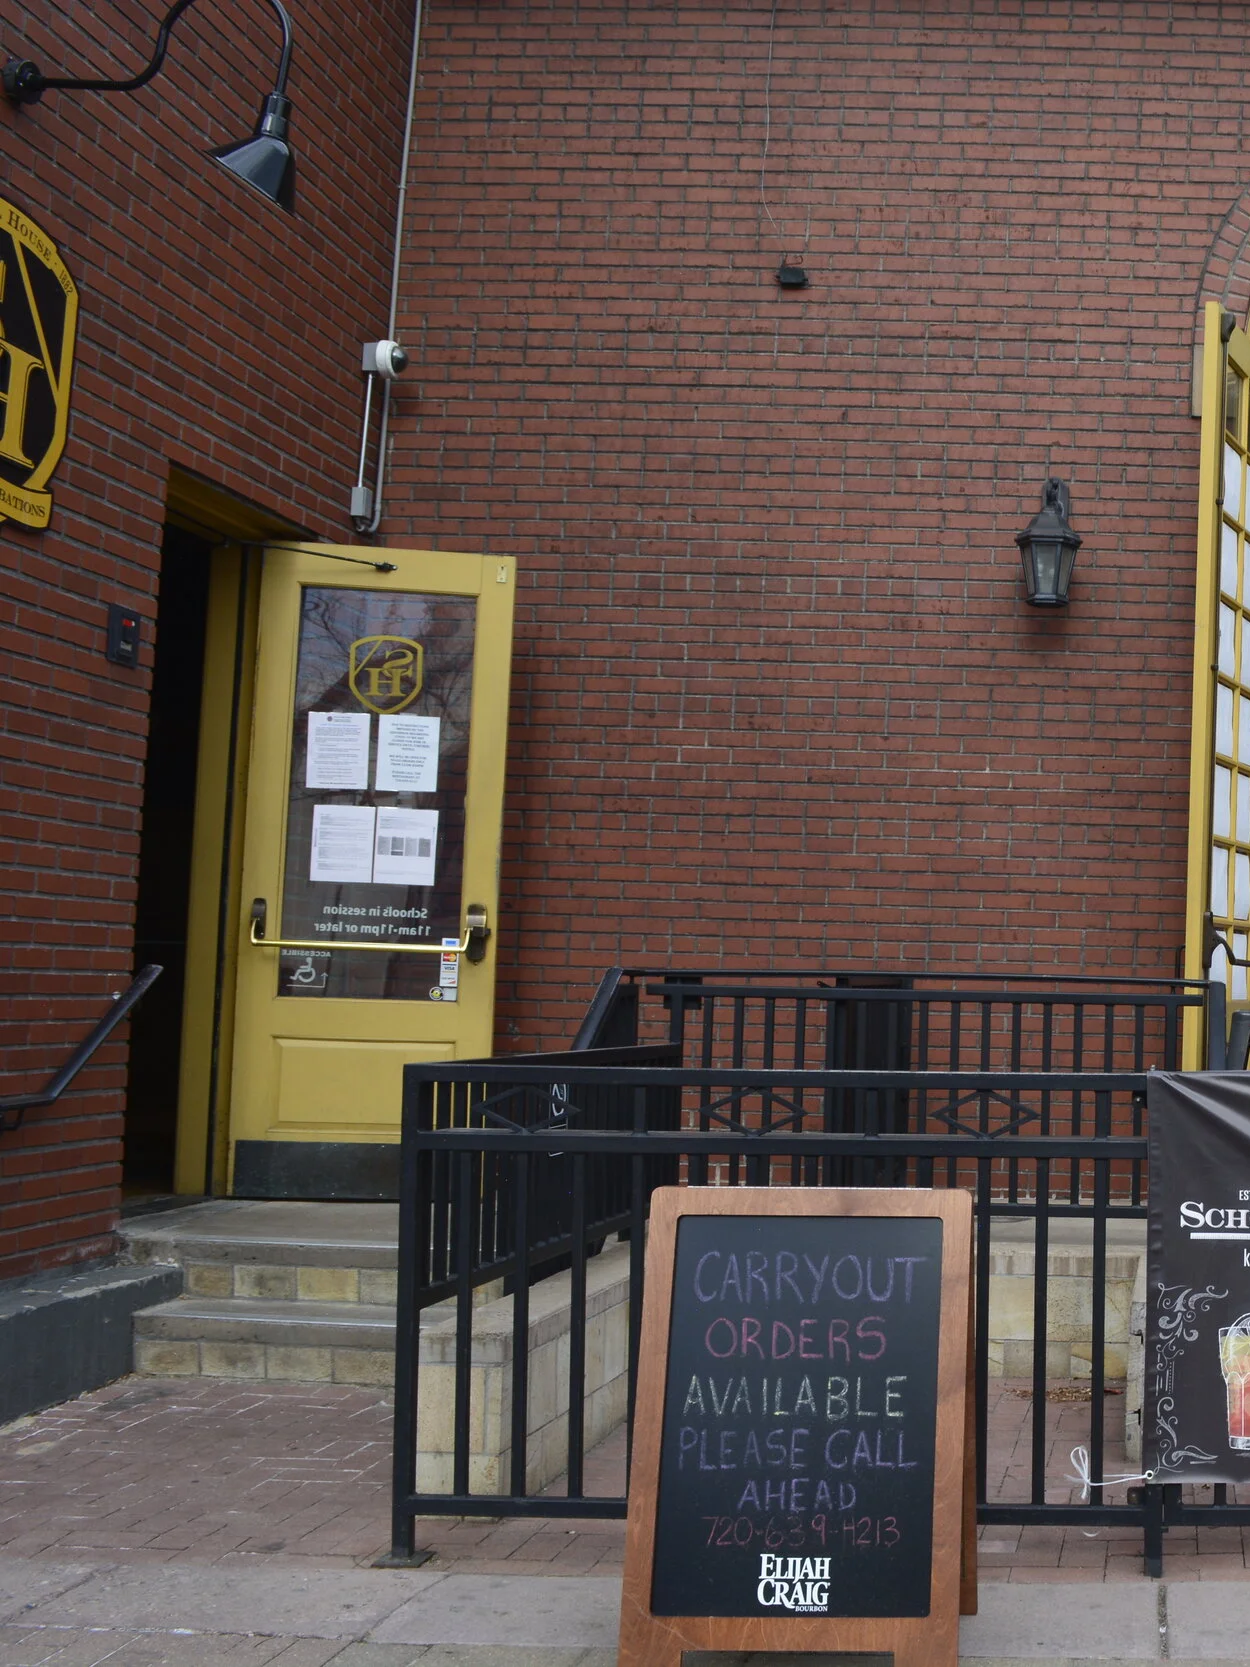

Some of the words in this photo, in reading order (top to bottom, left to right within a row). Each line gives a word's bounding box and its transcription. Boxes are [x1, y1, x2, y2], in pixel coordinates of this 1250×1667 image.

[7, 208, 52, 261] HOUSE
[58, 269, 74, 297] 1882
[0, 488, 46, 518] BATIONS
[693, 1250, 928, 1304] CARRYOUT
[704, 1315, 888, 1366] ORDERS
[683, 1374, 909, 1421] AVAILABLE
[678, 1427, 811, 1471] PLEASE
[824, 1429, 918, 1469] CALL
[737, 1478, 857, 1511] AHEAD
[702, 1514, 902, 1549] 720-639-4213
[758, 1553, 832, 1584] ELIJAH
[757, 1578, 831, 1609] CRAIG
